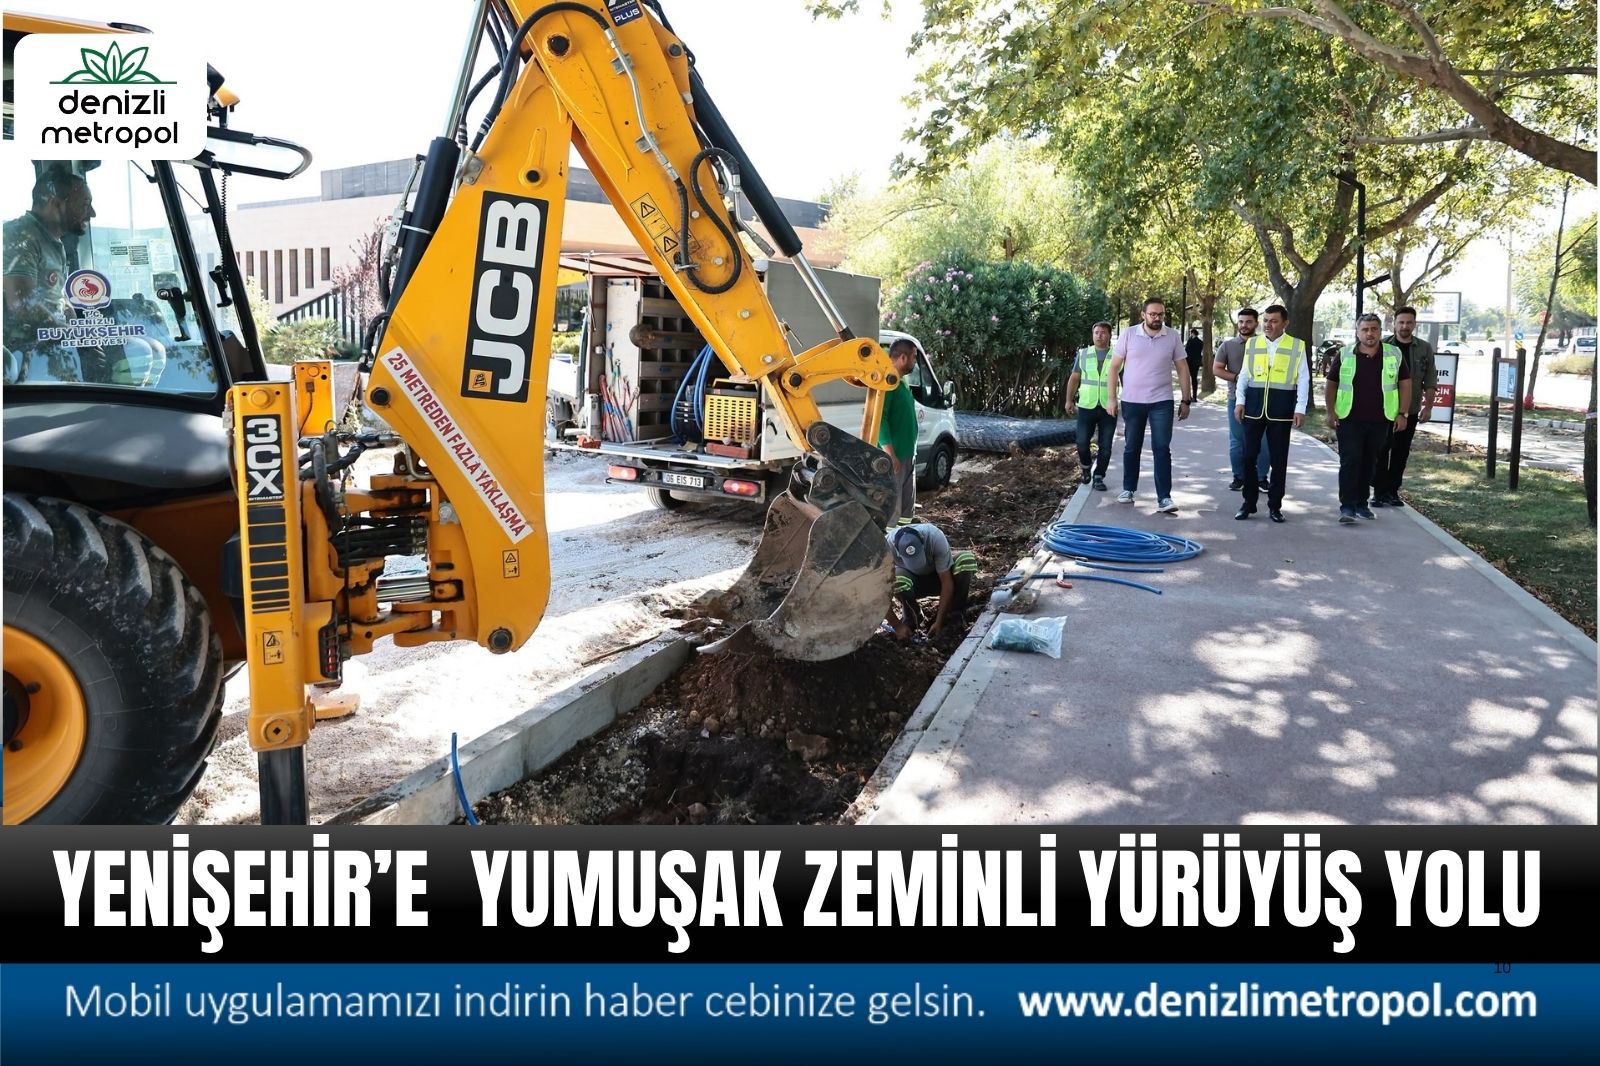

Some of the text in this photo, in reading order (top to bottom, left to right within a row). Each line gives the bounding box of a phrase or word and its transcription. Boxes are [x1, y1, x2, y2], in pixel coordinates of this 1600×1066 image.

[614, 8, 640, 23] PLUS
[471, 199, 542, 396] JCB
[246, 418, 283, 496] 3CX
[388, 353, 526, 536] 25 METREDEN FAZLA YAKLAŞMA
